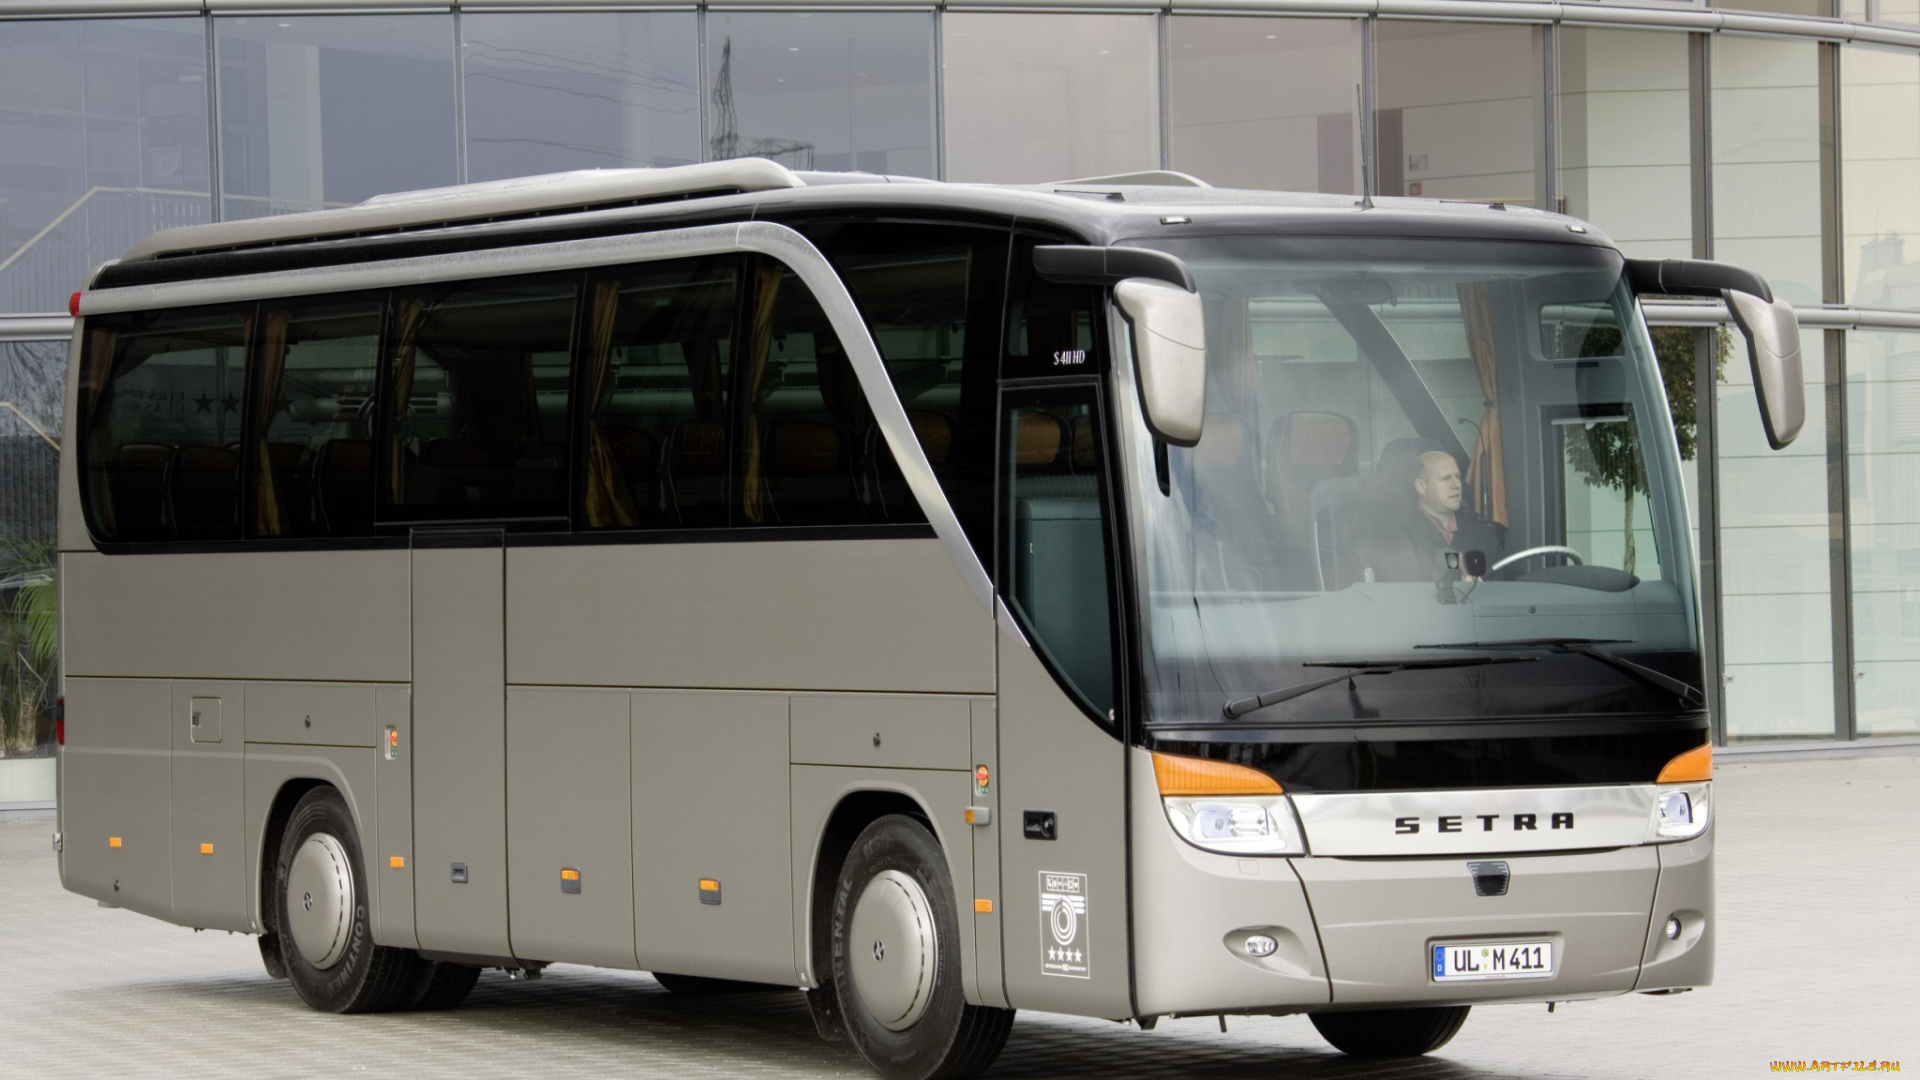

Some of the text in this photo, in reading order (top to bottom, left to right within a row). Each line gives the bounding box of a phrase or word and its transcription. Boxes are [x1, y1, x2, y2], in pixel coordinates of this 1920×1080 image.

[1053, 350, 1086, 366] S 411 HD
[1395, 812, 1574, 835] SETRA
[1437, 946, 1544, 972] D UL M 411
